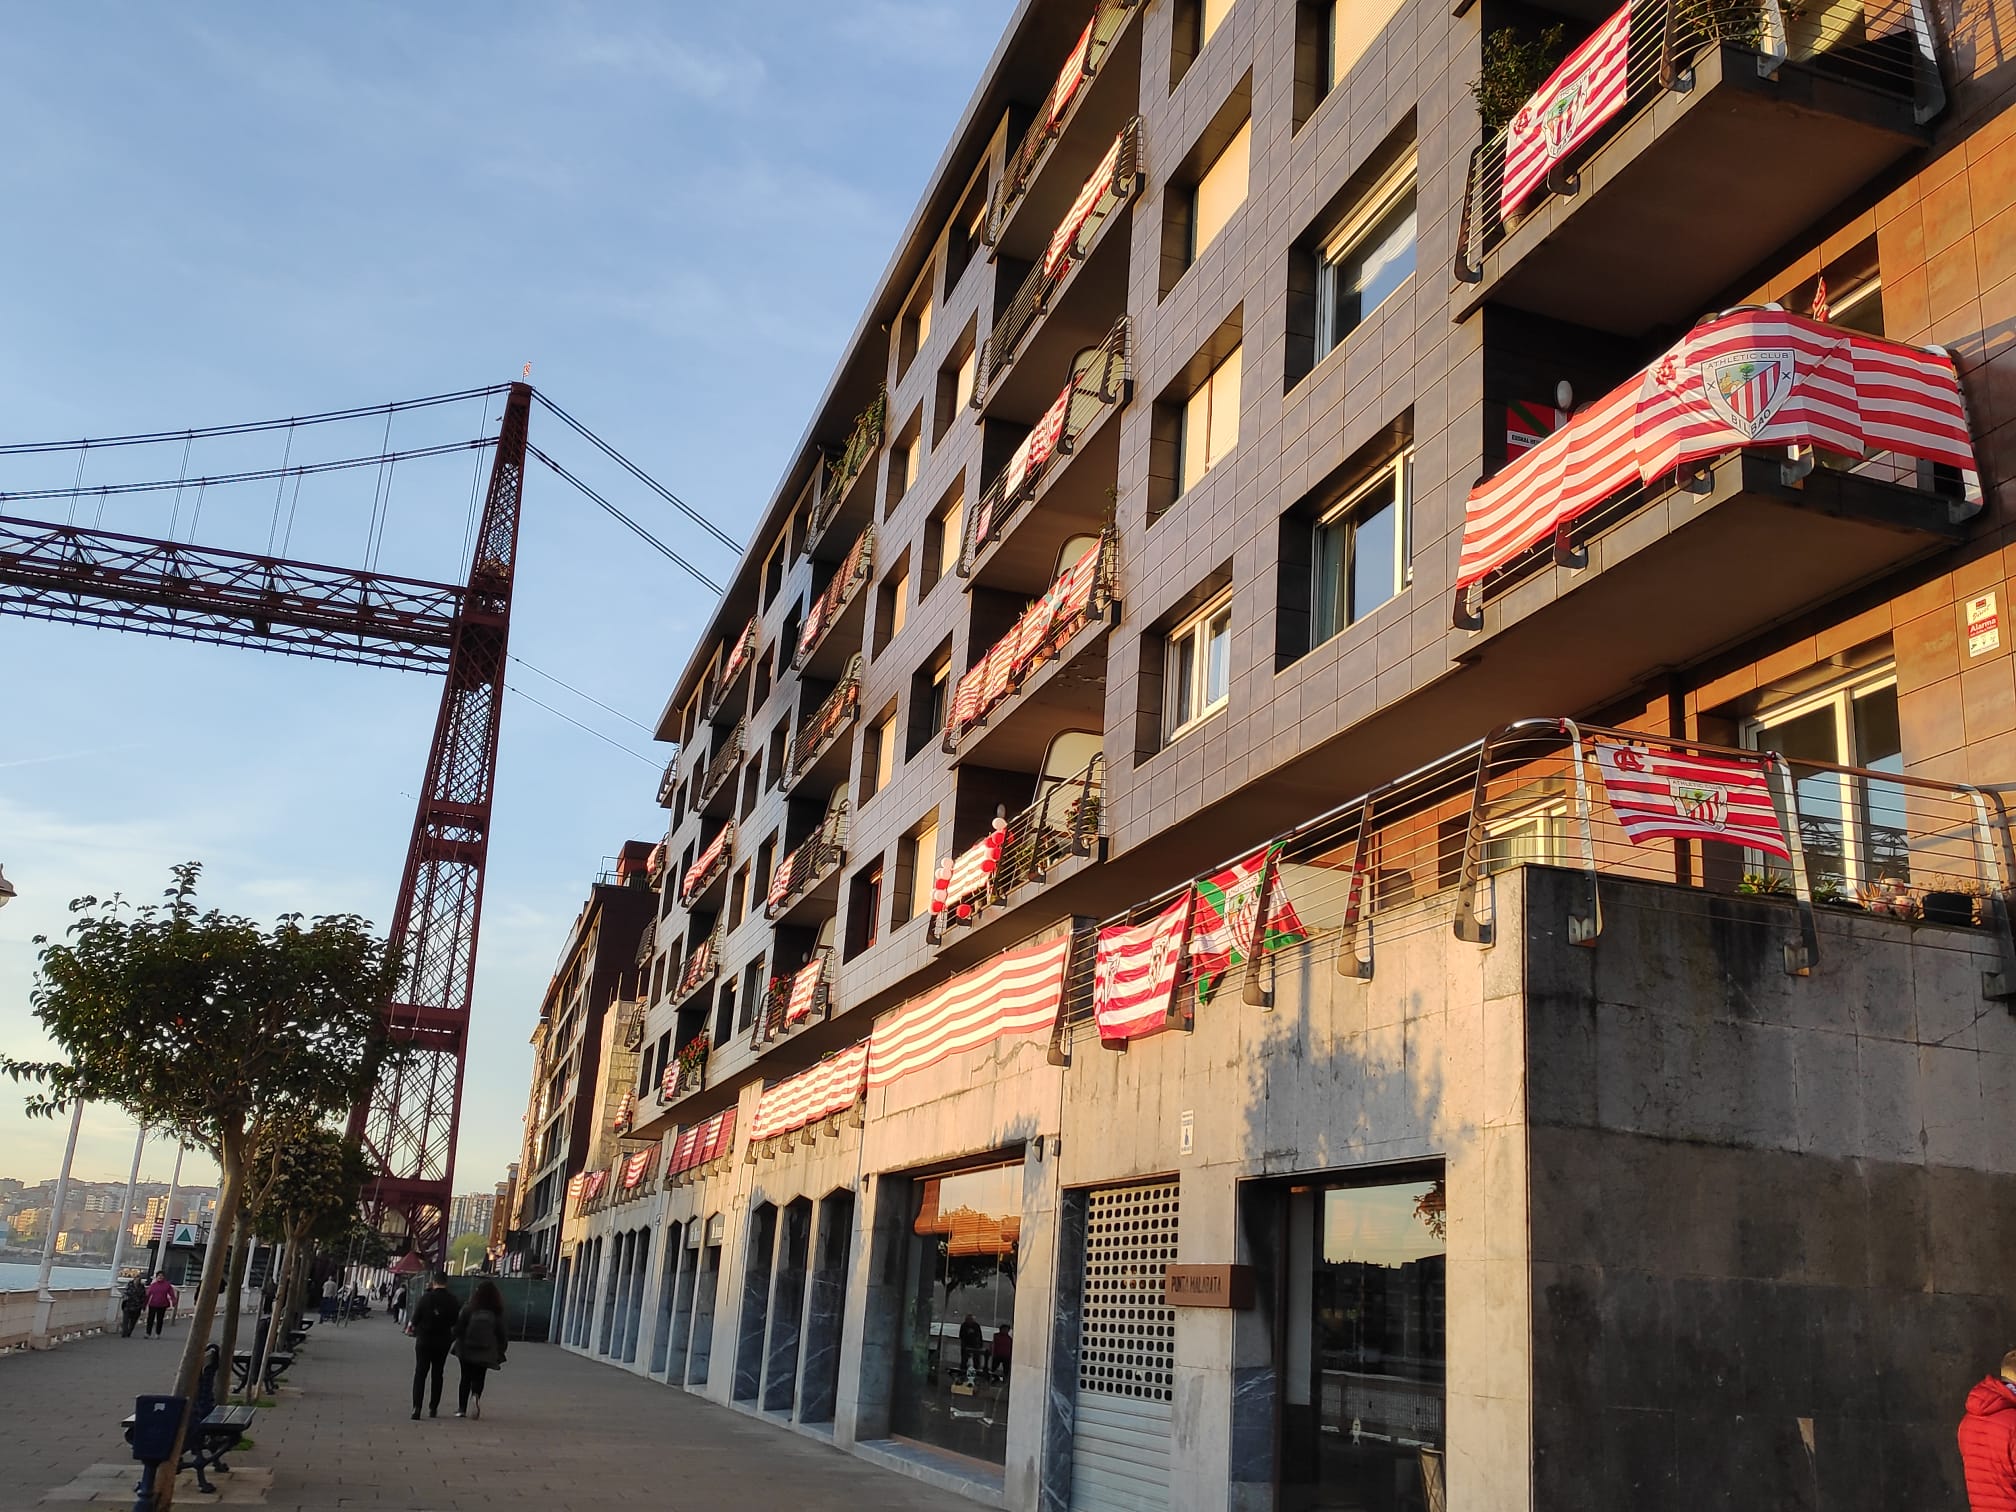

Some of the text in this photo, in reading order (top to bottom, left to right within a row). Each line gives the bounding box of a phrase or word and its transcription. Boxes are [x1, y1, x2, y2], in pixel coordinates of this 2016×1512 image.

[1707, 353, 1757, 369] ATHLETIC
[1731, 409, 1771, 435] BILBAO
[1970, 618, 1997, 633] Alarma
